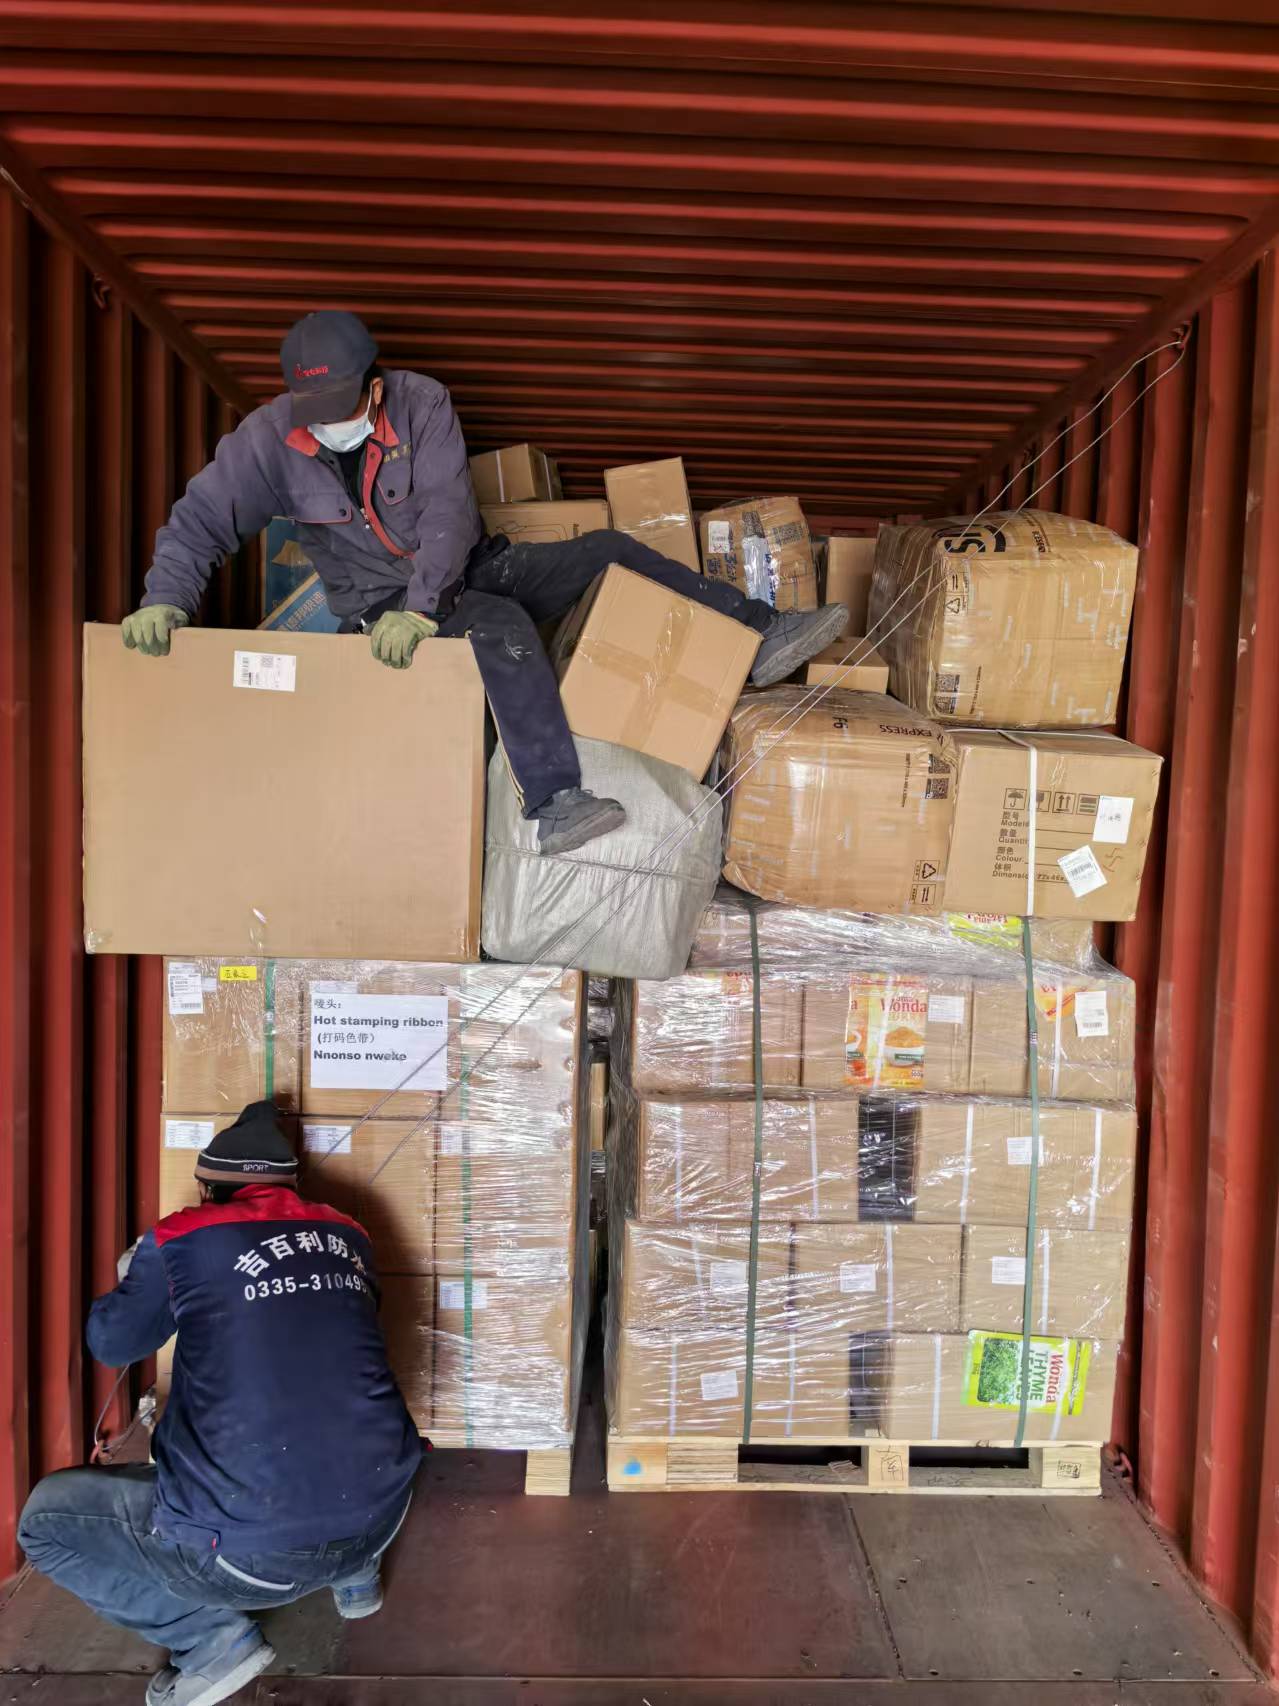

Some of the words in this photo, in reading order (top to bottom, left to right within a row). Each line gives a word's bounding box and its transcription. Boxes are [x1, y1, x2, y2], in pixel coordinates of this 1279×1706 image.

[880, 725, 932, 737] EXPRESS
[314, 1015, 337, 1025] Hot
[340, 1016, 400, 1029] stamping
[403, 1017, 443, 1027] ribbon
[314, 1050, 361, 1060] Nnonso
[365, 1049, 407, 1061] nweke
[243, 1164, 269, 1172] SPORT
[1029, 1350, 1049, 1401] THYME
